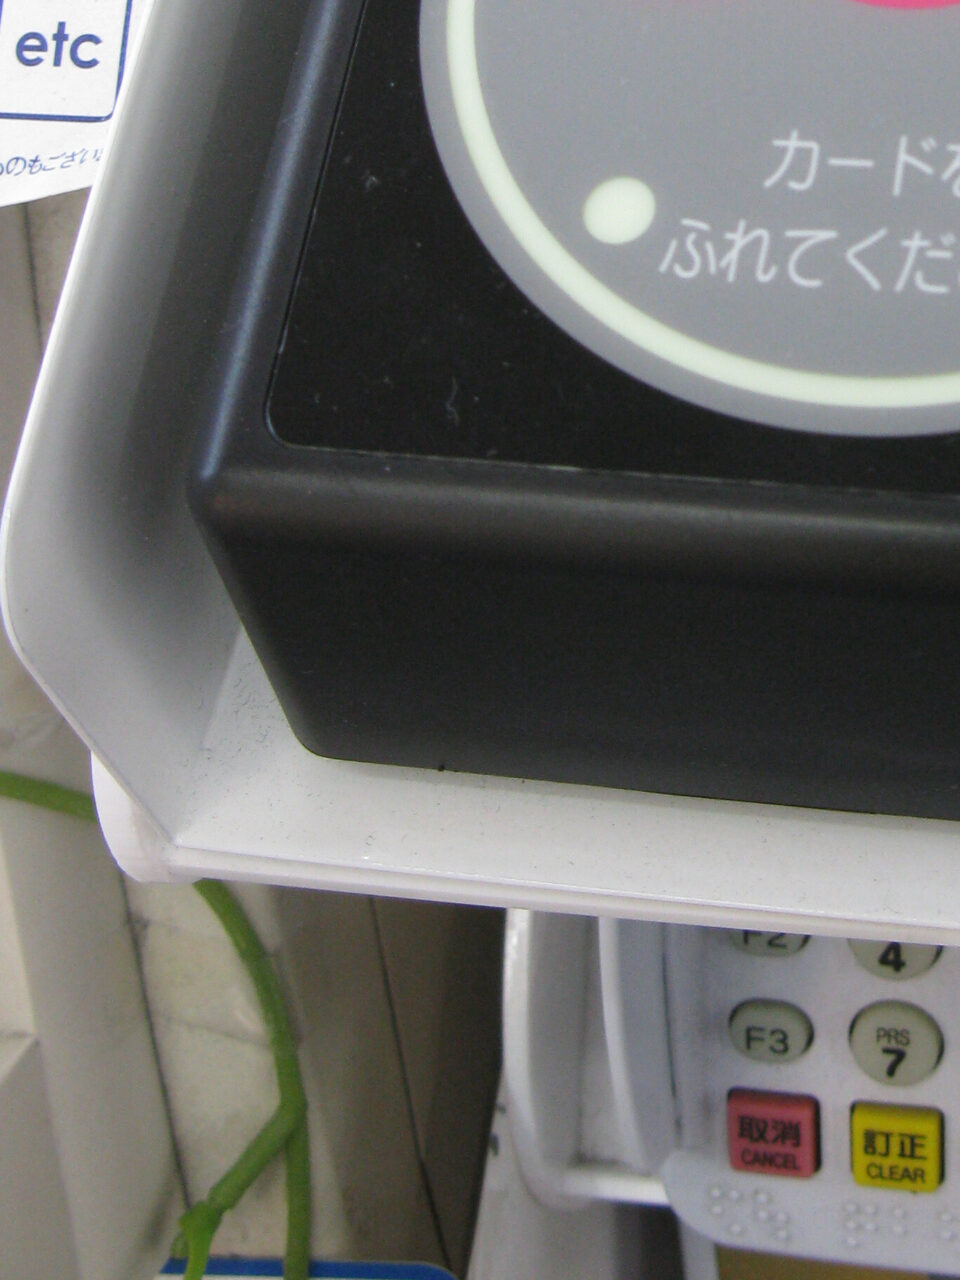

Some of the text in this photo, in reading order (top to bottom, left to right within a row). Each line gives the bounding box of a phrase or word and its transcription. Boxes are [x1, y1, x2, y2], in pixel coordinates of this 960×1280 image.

[15, 21, 103, 70] etc
[878, 941, 906, 973] 4
[745, 1025, 789, 1055] F3
[876, 1027, 911, 1047] PRS
[882, 1047, 906, 1078] 7
[738, 1115, 802, 1148] 取消
[864, 1128, 927, 1160] 訂正
[740, 1149, 800, 1171] CANCEL
[866, 1163, 926, 1184] CLEAR
